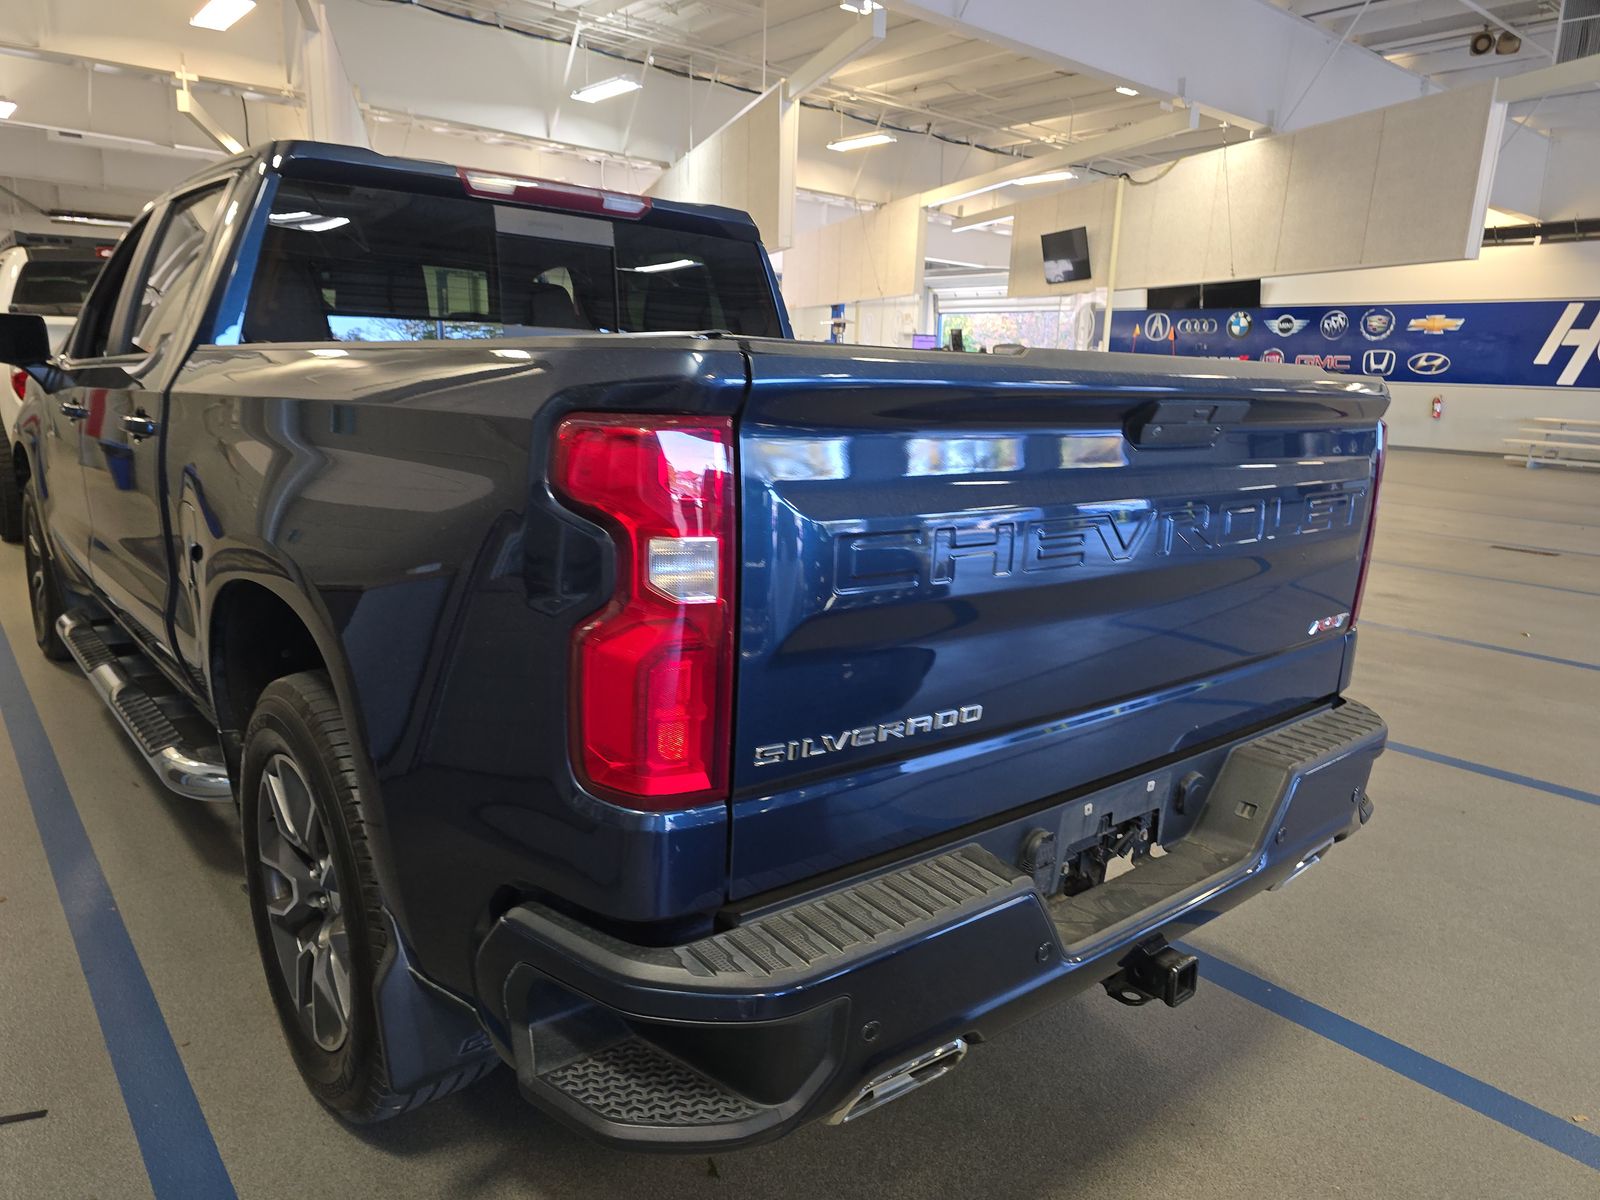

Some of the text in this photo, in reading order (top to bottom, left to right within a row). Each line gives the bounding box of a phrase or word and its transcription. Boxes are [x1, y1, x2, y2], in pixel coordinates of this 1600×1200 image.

[1295, 354, 1351, 370] GMC
[1533, 302, 1600, 386] H
[833, 487, 1367, 596] CHEVROLET
[753, 704, 983, 767] SILVERADO
